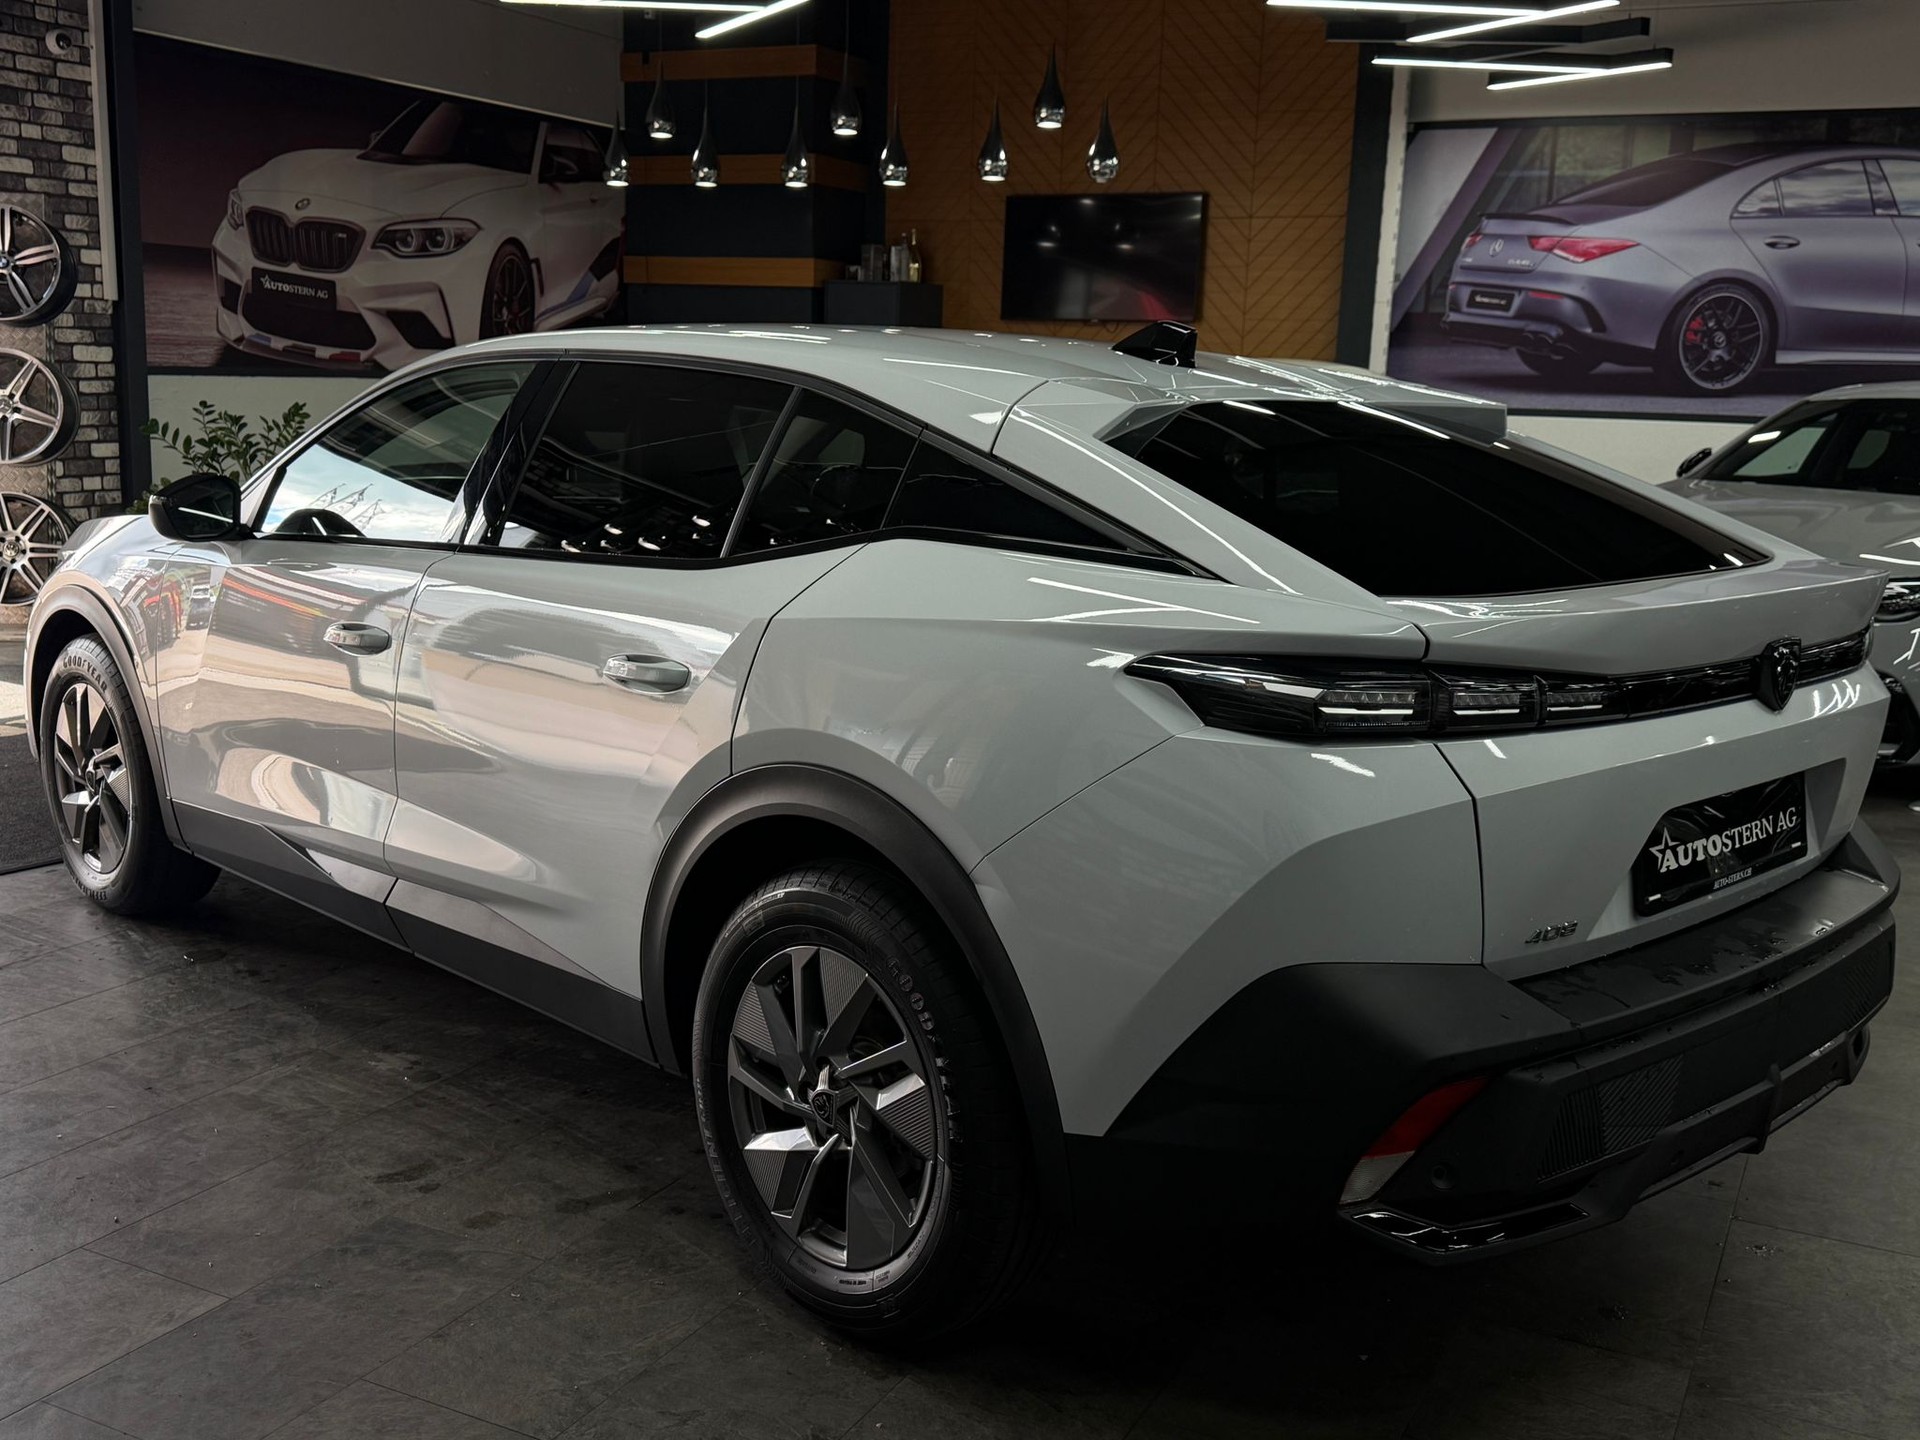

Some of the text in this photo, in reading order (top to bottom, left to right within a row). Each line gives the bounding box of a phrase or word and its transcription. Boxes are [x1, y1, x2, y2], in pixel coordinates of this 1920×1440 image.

[264, 281, 328, 299] AUTOSTERN AG
[63, 655, 107, 693] GOODYEAR
[1660, 807, 1797, 873] AUTOSTERN AG
[1713, 868, 1752, 890] AUTO-STERN.CH
